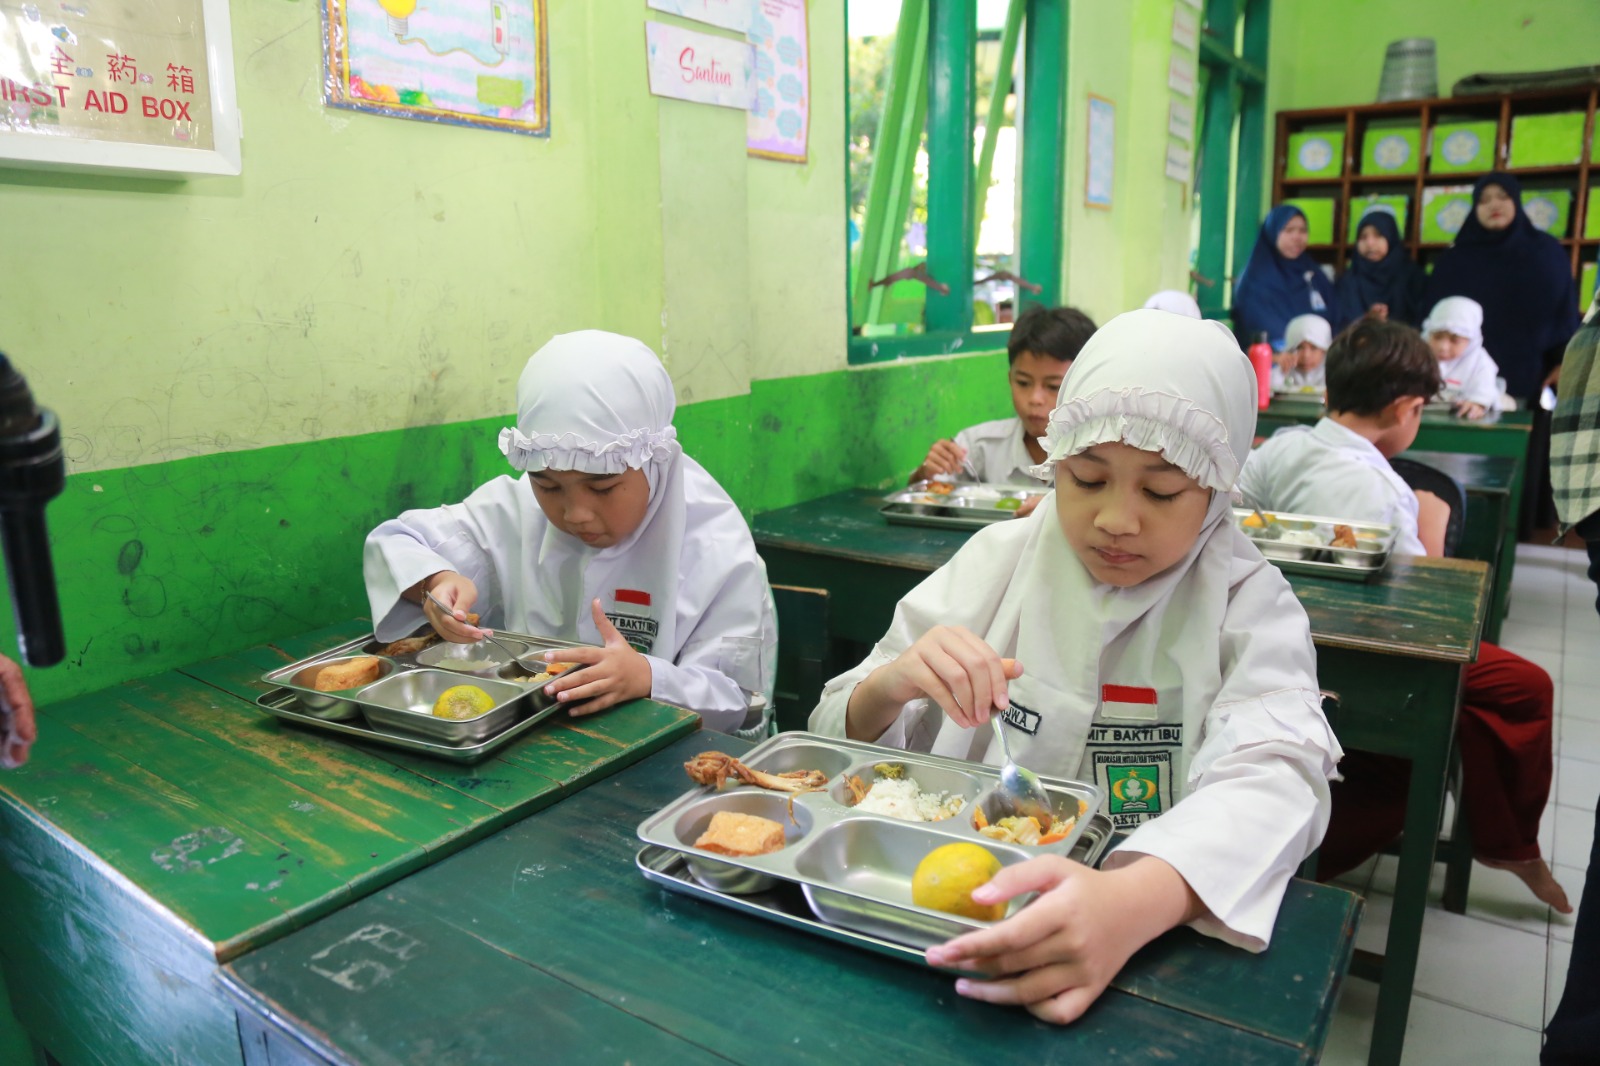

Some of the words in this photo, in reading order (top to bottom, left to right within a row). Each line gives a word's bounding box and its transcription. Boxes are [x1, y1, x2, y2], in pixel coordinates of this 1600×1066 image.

[679, 46, 732, 86] Santun
[0, 78, 70, 108] IRST
[84, 89, 128, 114] AID
[141, 95, 192, 122] BOX
[1113, 729, 1153, 741] BAKTI
[1159, 729, 1180, 741] IBU
[1108, 813, 1141, 826] AKTI
